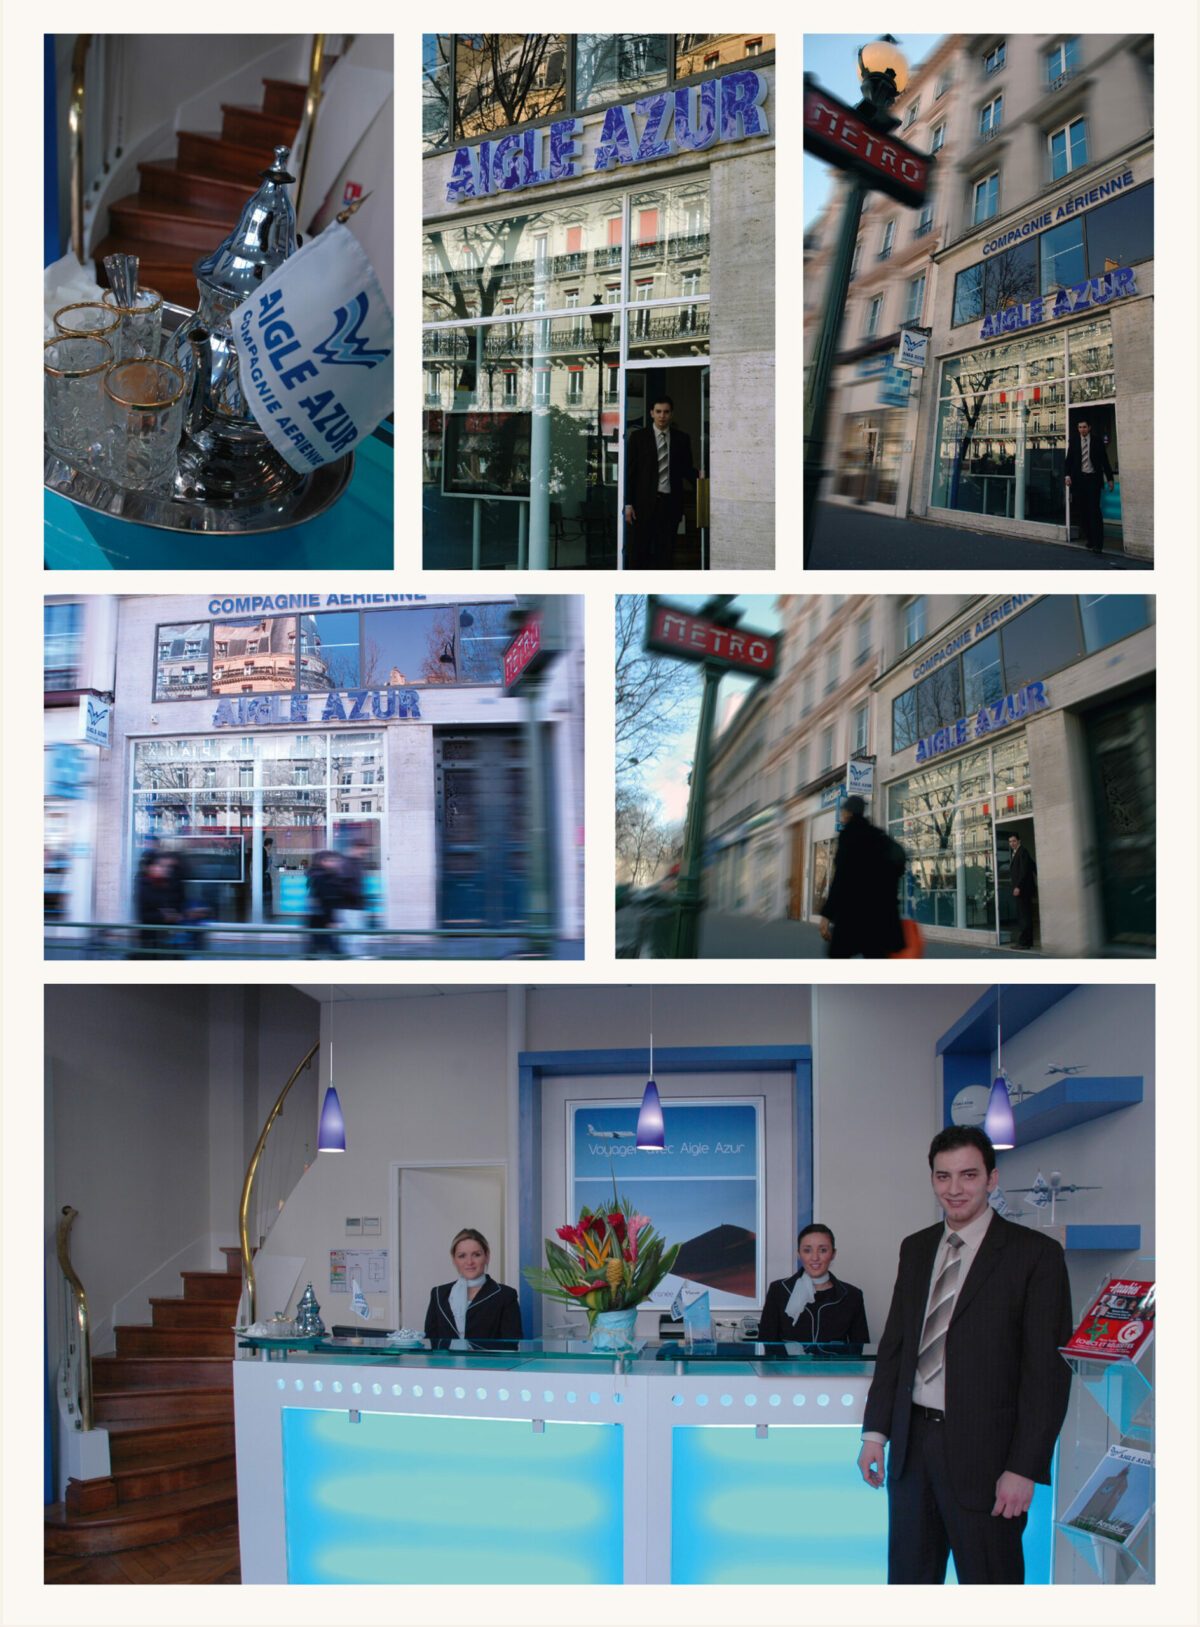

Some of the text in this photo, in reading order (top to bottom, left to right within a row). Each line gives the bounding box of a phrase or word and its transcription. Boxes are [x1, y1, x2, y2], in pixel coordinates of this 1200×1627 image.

[446, 70, 771, 204] AIGLE AZUR
[982, 169, 1136, 256] COMPAGNIE AÉRIENNE
[979, 266, 1140, 340] AIGLE AZUR
[240, 309, 283, 415] COMPAGNIE
[258, 288, 359, 454] AIGLE AZUR
[208, 594, 321, 615] COMPAGNIE
[912, 628, 972, 680] COMPAGNIE
[212, 689, 422, 727] AIGLE AZUR
[915, 680, 1051, 763] AIGLE AZUR
[680, 1142, 709, 1157] Aigle
[714, 1142, 745, 1154] Azur
